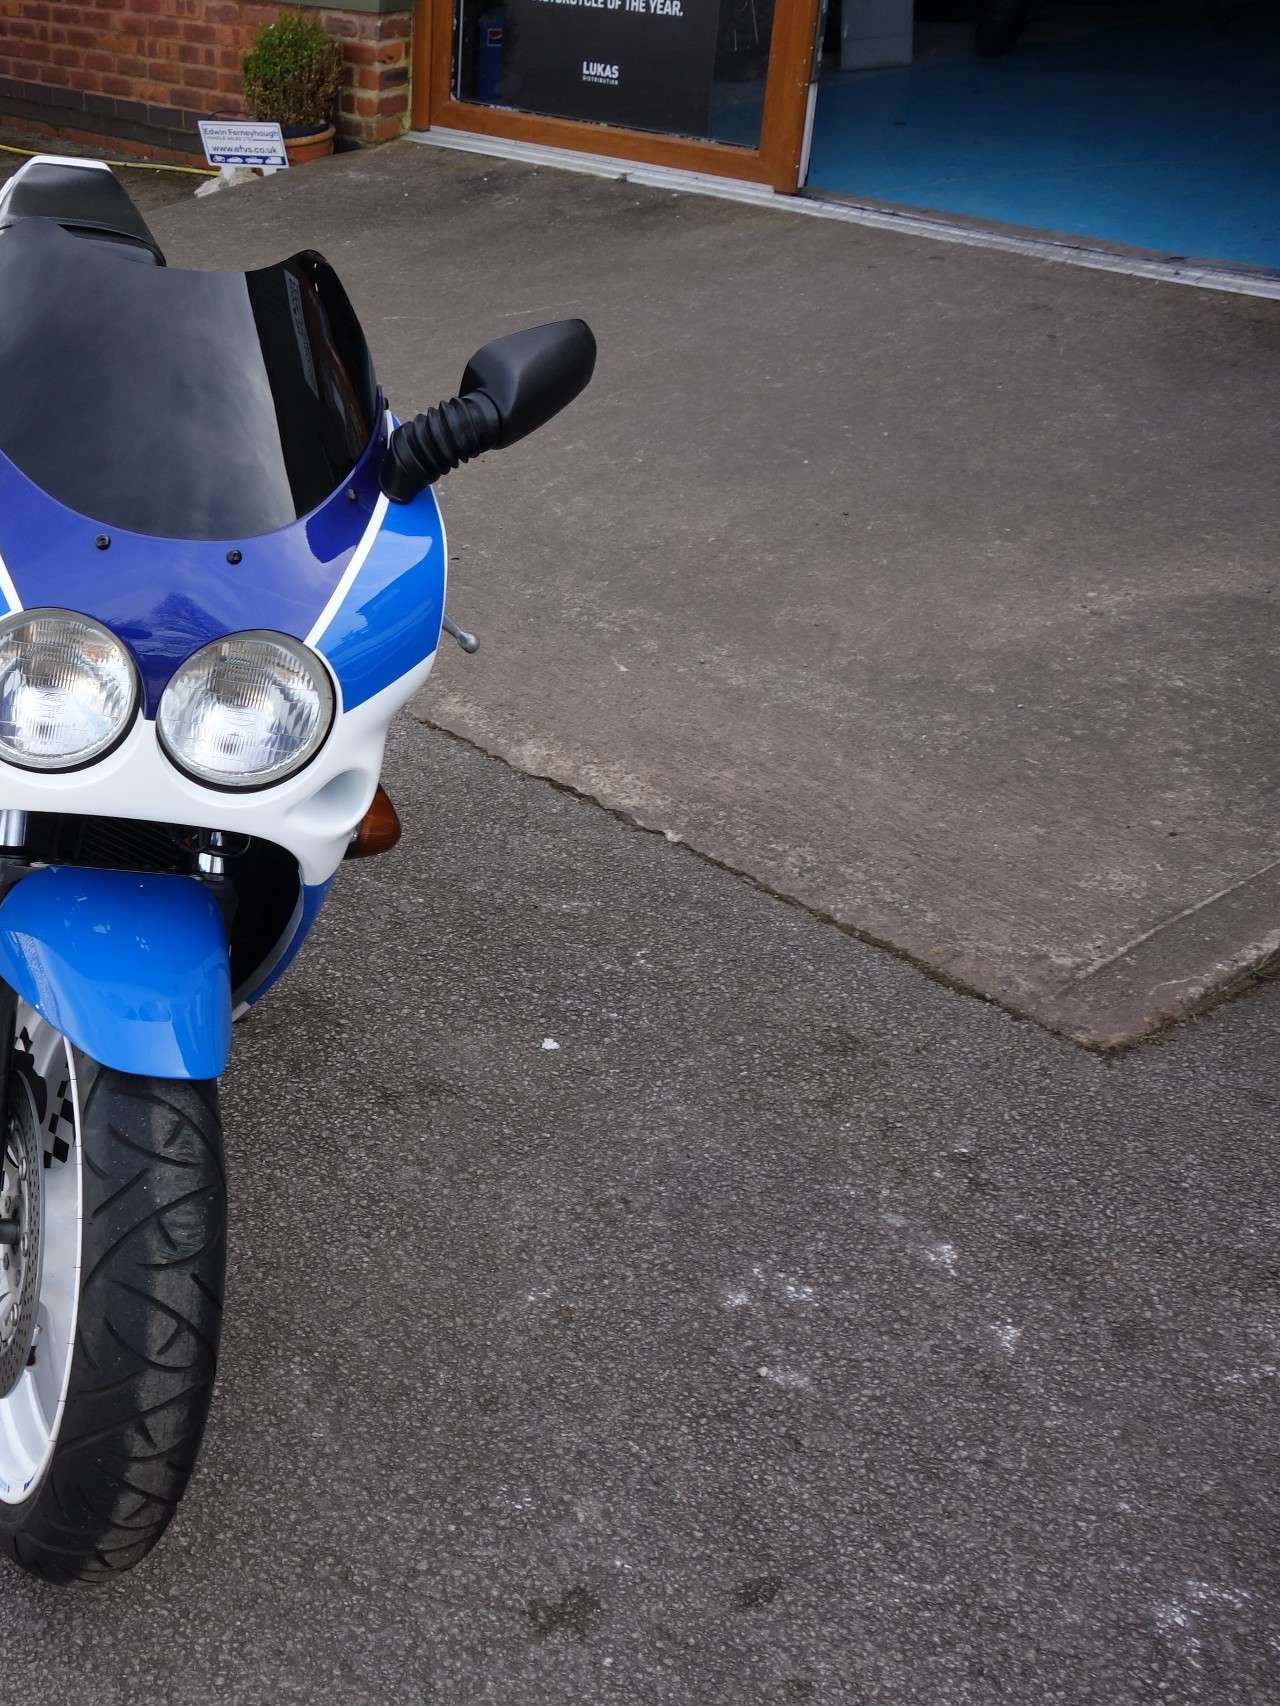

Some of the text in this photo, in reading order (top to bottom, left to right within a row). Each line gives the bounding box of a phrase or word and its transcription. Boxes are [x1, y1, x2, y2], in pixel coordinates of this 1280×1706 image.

[607, 0, 622, 10] OF
[626, 0, 646, 13] THE
[650, 0, 683, 16] YEAR.
[582, 61, 619, 79] LUKAS
[204, 127, 227, 136] Edwin
